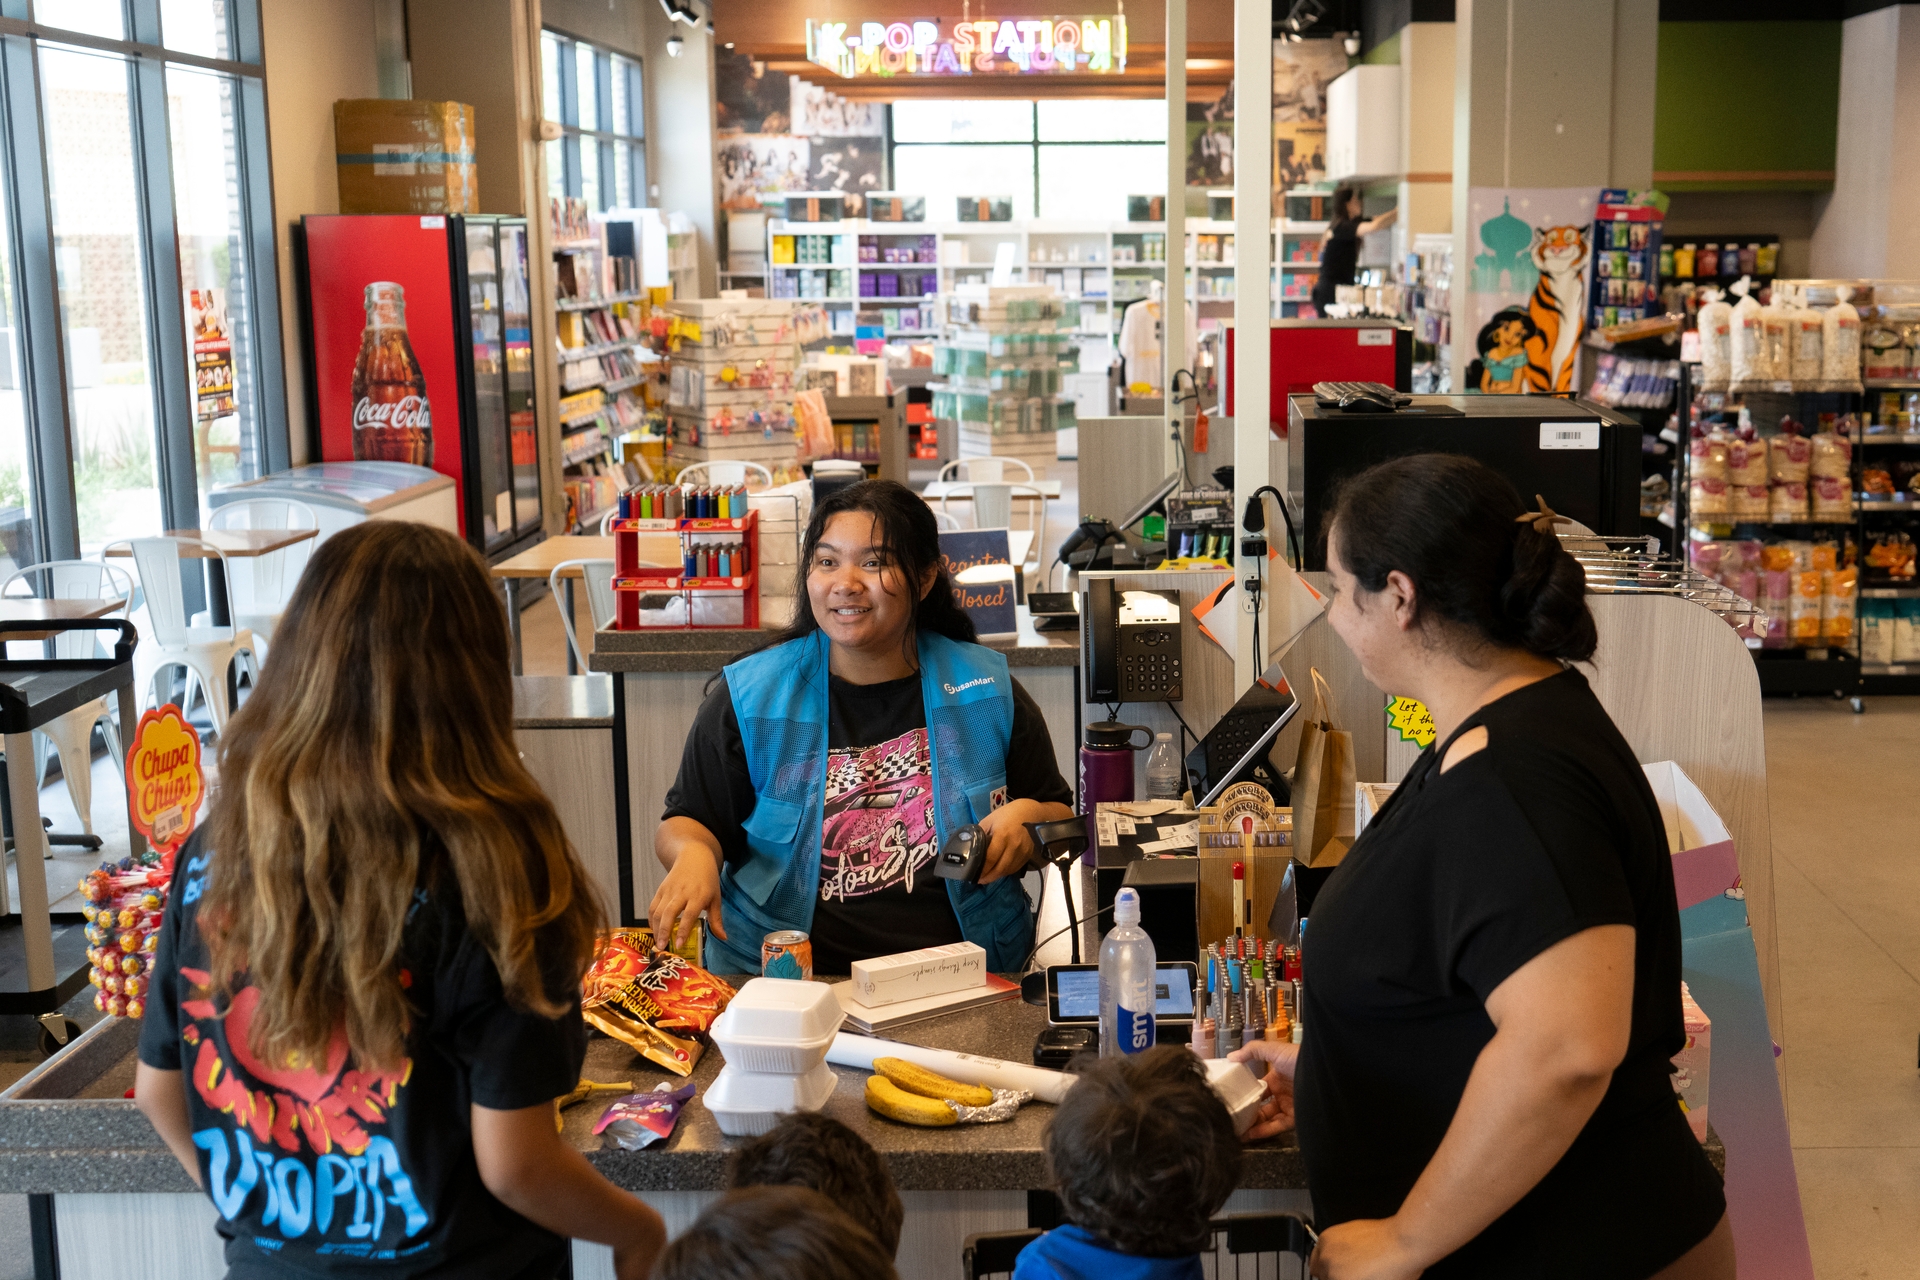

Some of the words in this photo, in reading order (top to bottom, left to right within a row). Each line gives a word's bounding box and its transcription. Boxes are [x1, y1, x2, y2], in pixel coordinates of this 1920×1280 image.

[821, 21, 938, 55] K-POP
[953, 20, 1111, 54] STATION
[353, 395, 431, 430] Coca-Cola
[1399, 700, 1418, 712] Let
[1403, 713, 1414, 725] if
[141, 743, 190, 782] Chupa
[143, 772, 192, 816] Chups
[911, 965, 934, 982] simple
[936, 960, 961, 974] things
[962, 957, 980, 971] Keep
[1132, 978, 1148, 1049] smart
